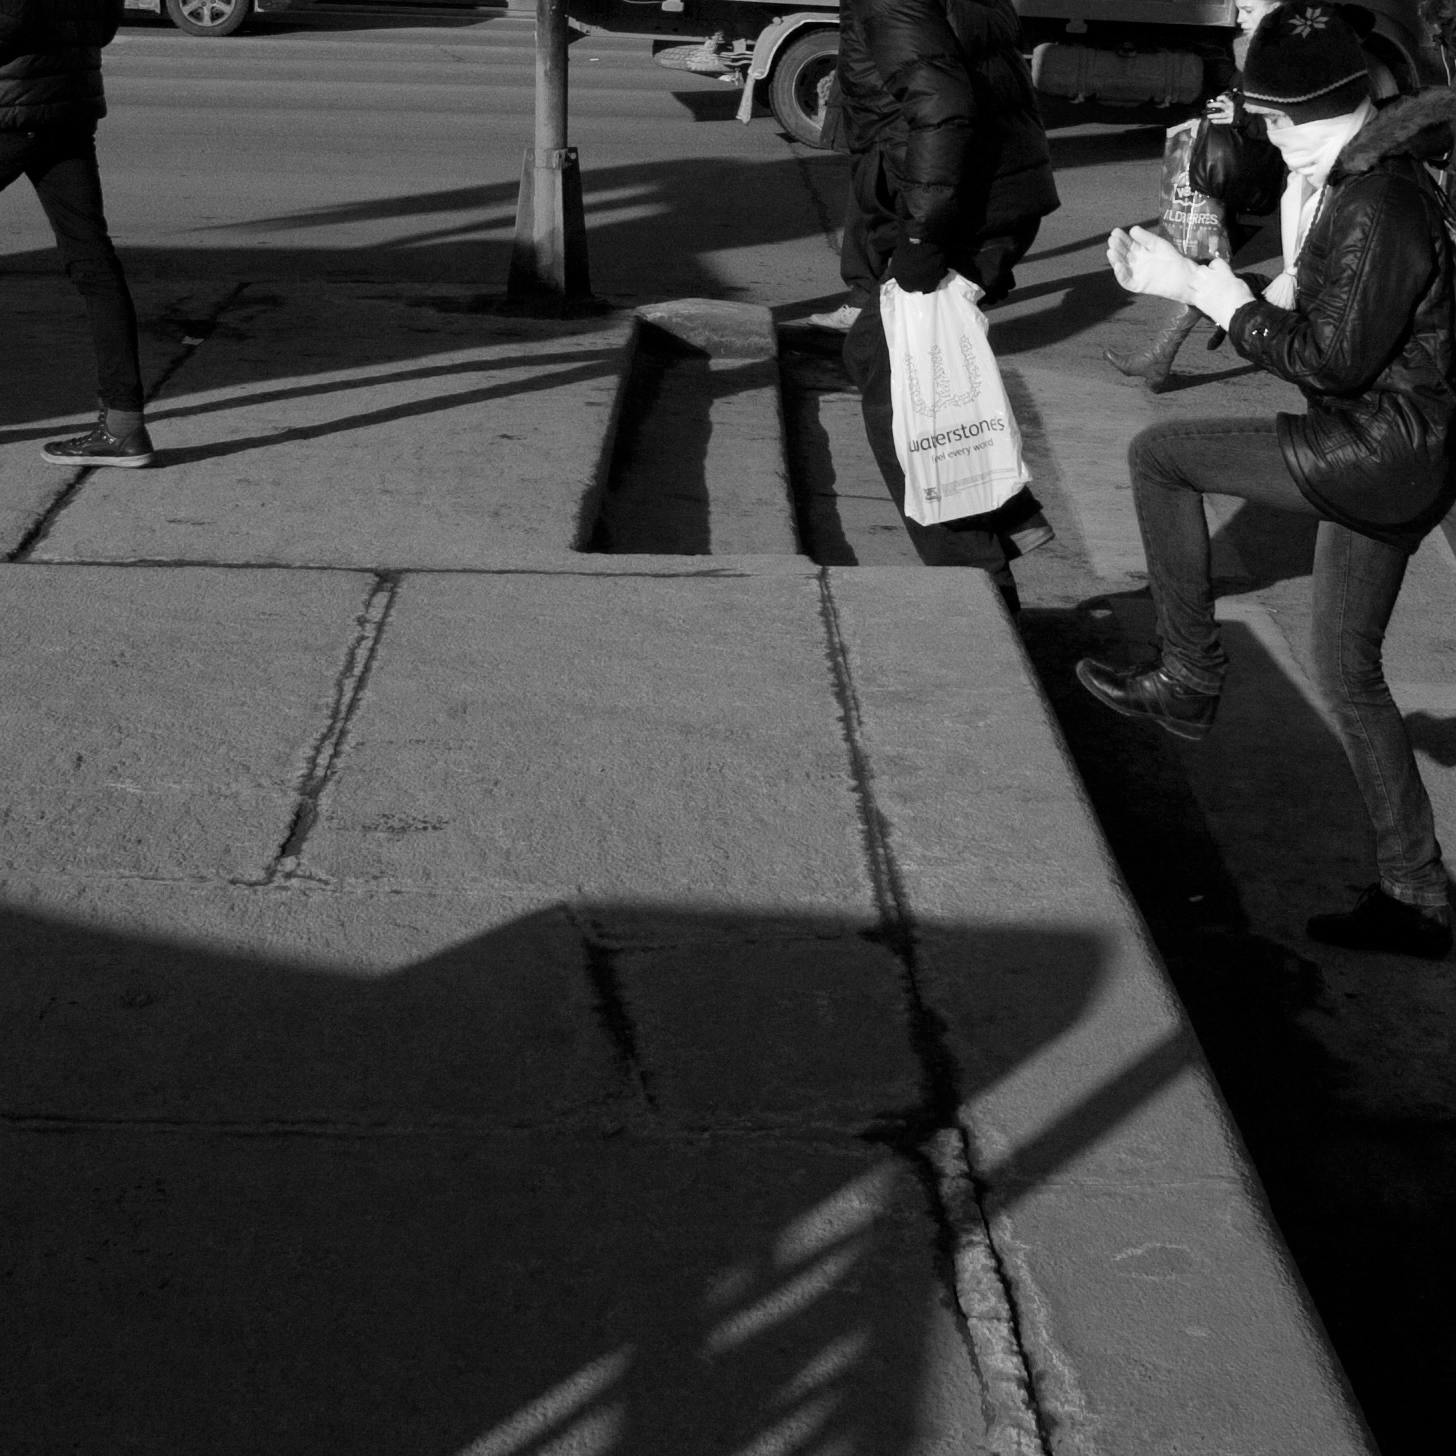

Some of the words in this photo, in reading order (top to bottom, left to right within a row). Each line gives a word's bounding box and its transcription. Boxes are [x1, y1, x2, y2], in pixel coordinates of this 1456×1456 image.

[908, 418, 1005, 453] waterstones
[947, 445, 972, 458] every
[972, 437, 994, 452] word
